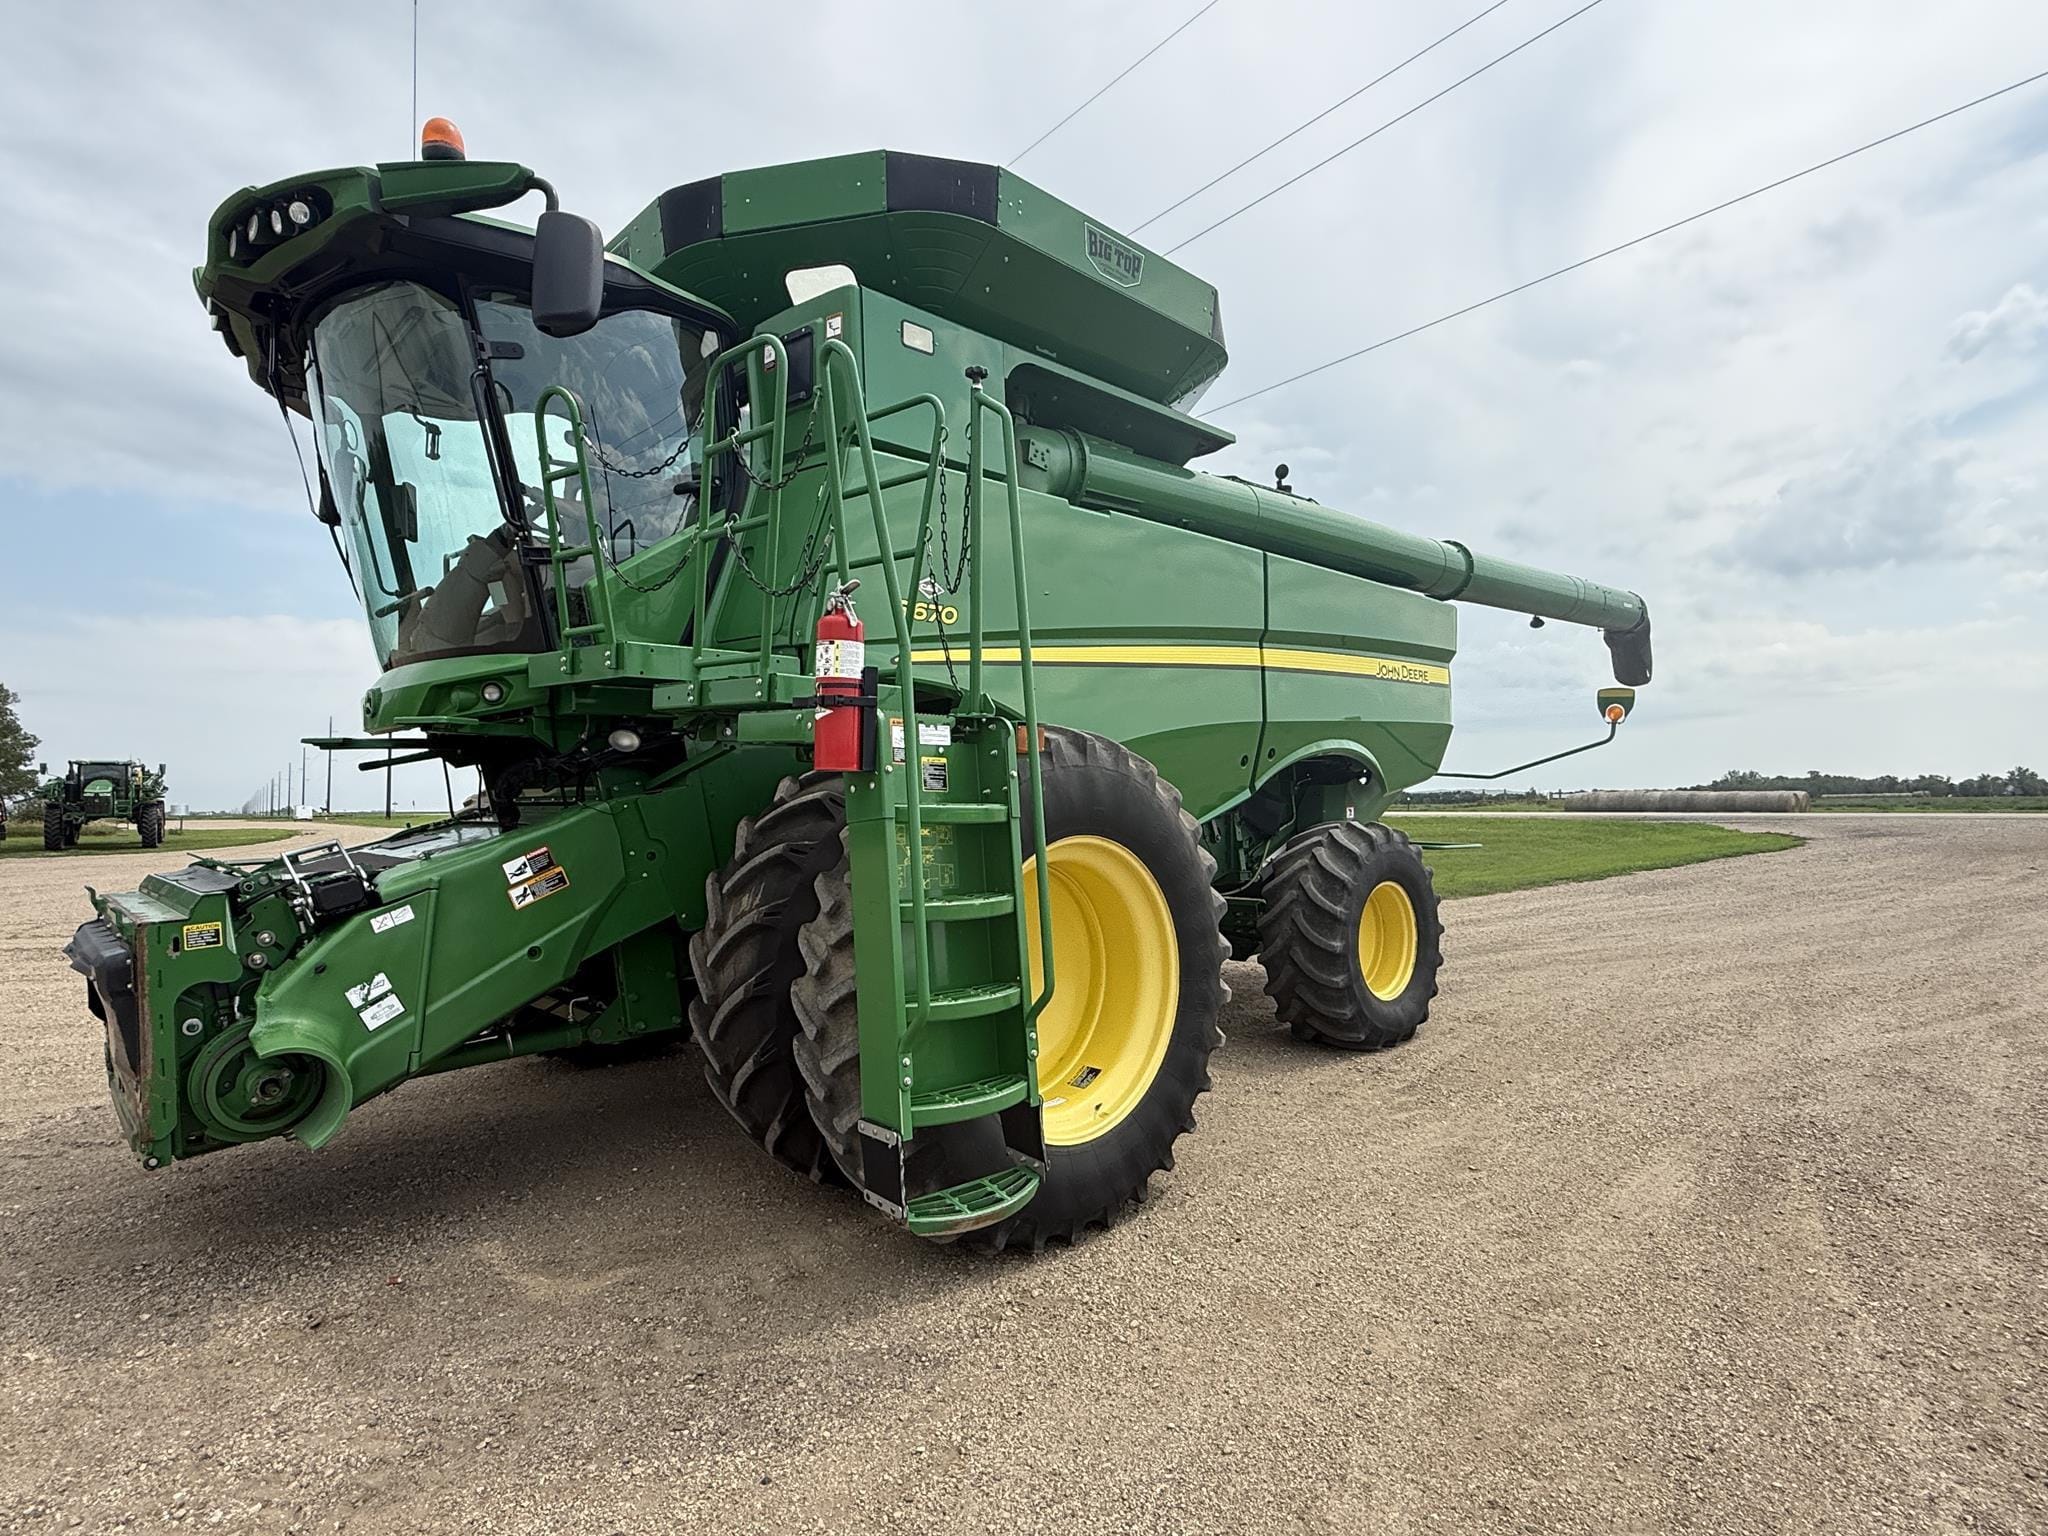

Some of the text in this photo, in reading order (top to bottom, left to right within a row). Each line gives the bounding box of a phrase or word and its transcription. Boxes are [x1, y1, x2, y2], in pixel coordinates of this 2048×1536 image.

[1088, 229, 1112, 262] BIG
[1114, 246, 1141, 279] TOP
[1376, 661, 1429, 682] JOHN DEERE
[190, 923, 220, 931] CAUTION
